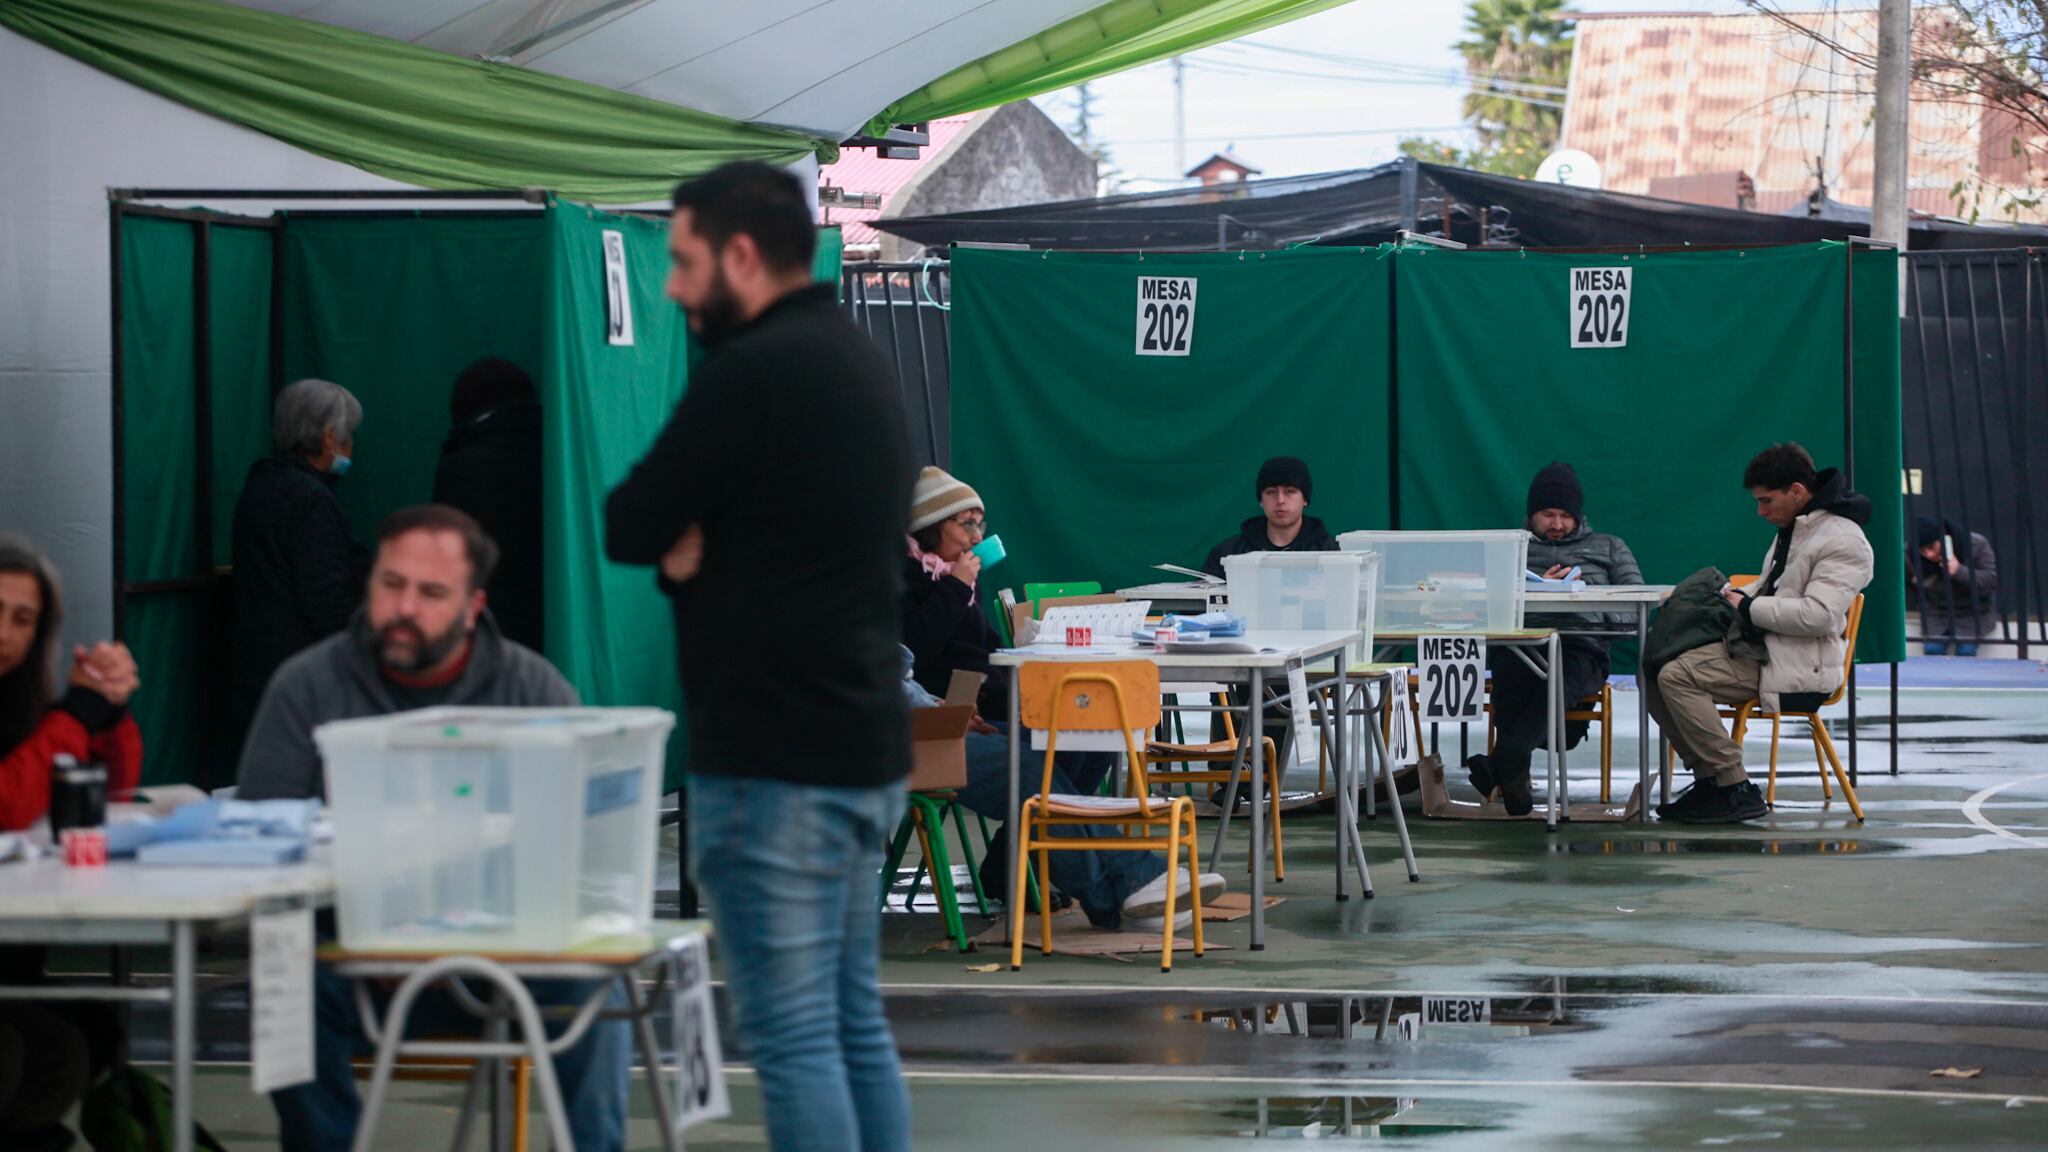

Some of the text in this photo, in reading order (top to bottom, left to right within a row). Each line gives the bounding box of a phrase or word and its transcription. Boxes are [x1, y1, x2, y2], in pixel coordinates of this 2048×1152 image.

[1142, 279, 1192, 300] MESA
[1575, 270, 1627, 291] MESA
[1142, 303, 1189, 351] 202
[1578, 294, 1625, 343] 202
[1423, 638, 1480, 660] MESA
[1427, 664, 1478, 717] 202
